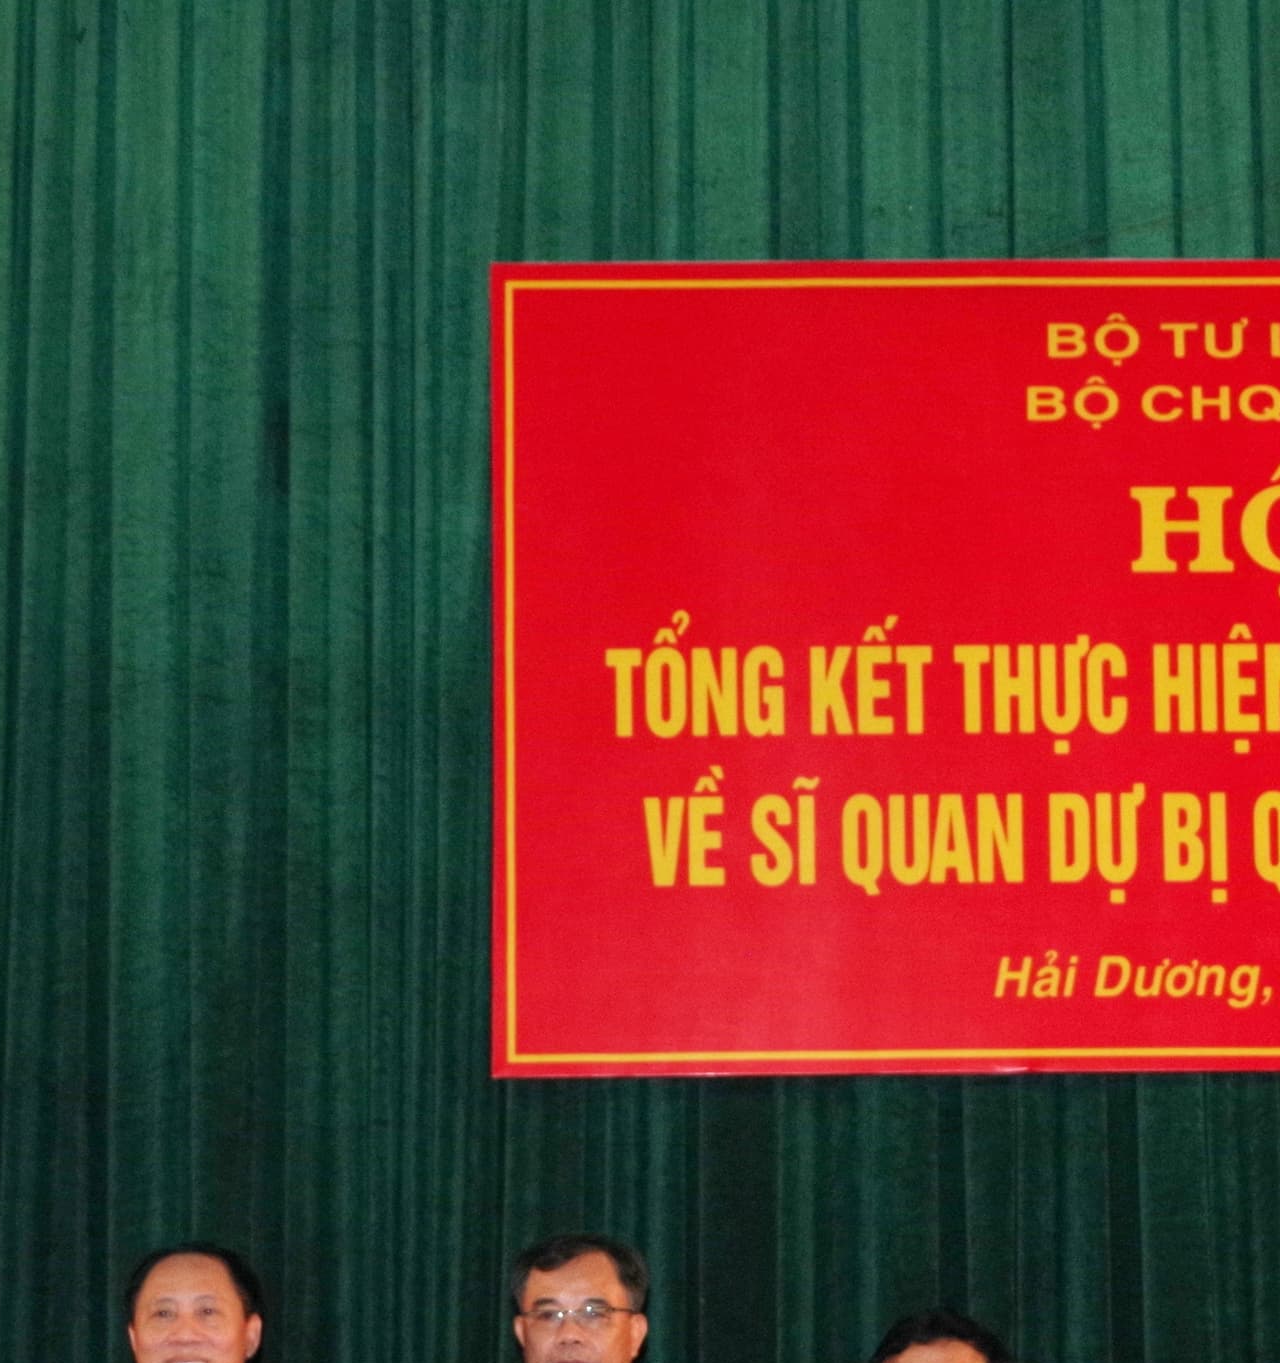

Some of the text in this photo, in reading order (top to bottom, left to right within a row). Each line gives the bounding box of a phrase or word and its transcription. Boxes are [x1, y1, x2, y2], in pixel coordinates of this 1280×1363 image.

[1047, 312, 1140, 367] BỘ
[1161, 318, 1248, 358] TƯ
[1027, 375, 1119, 430] BỘ
[605, 609, 785, 739] TỔNG
[809, 614, 933, 736] KẾT
[953, 633, 1128, 756] THỰC
[643, 764, 726, 887] VỀ
[750, 775, 820, 887] SĨ
[841, 792, 1024, 896] QUAN
[1048, 781, 1146, 904] DỰ
[1162, 791, 1229, 904] BỊ
[994, 949, 1079, 998] Hải
[1094, 955, 1272, 1009] Dương,
